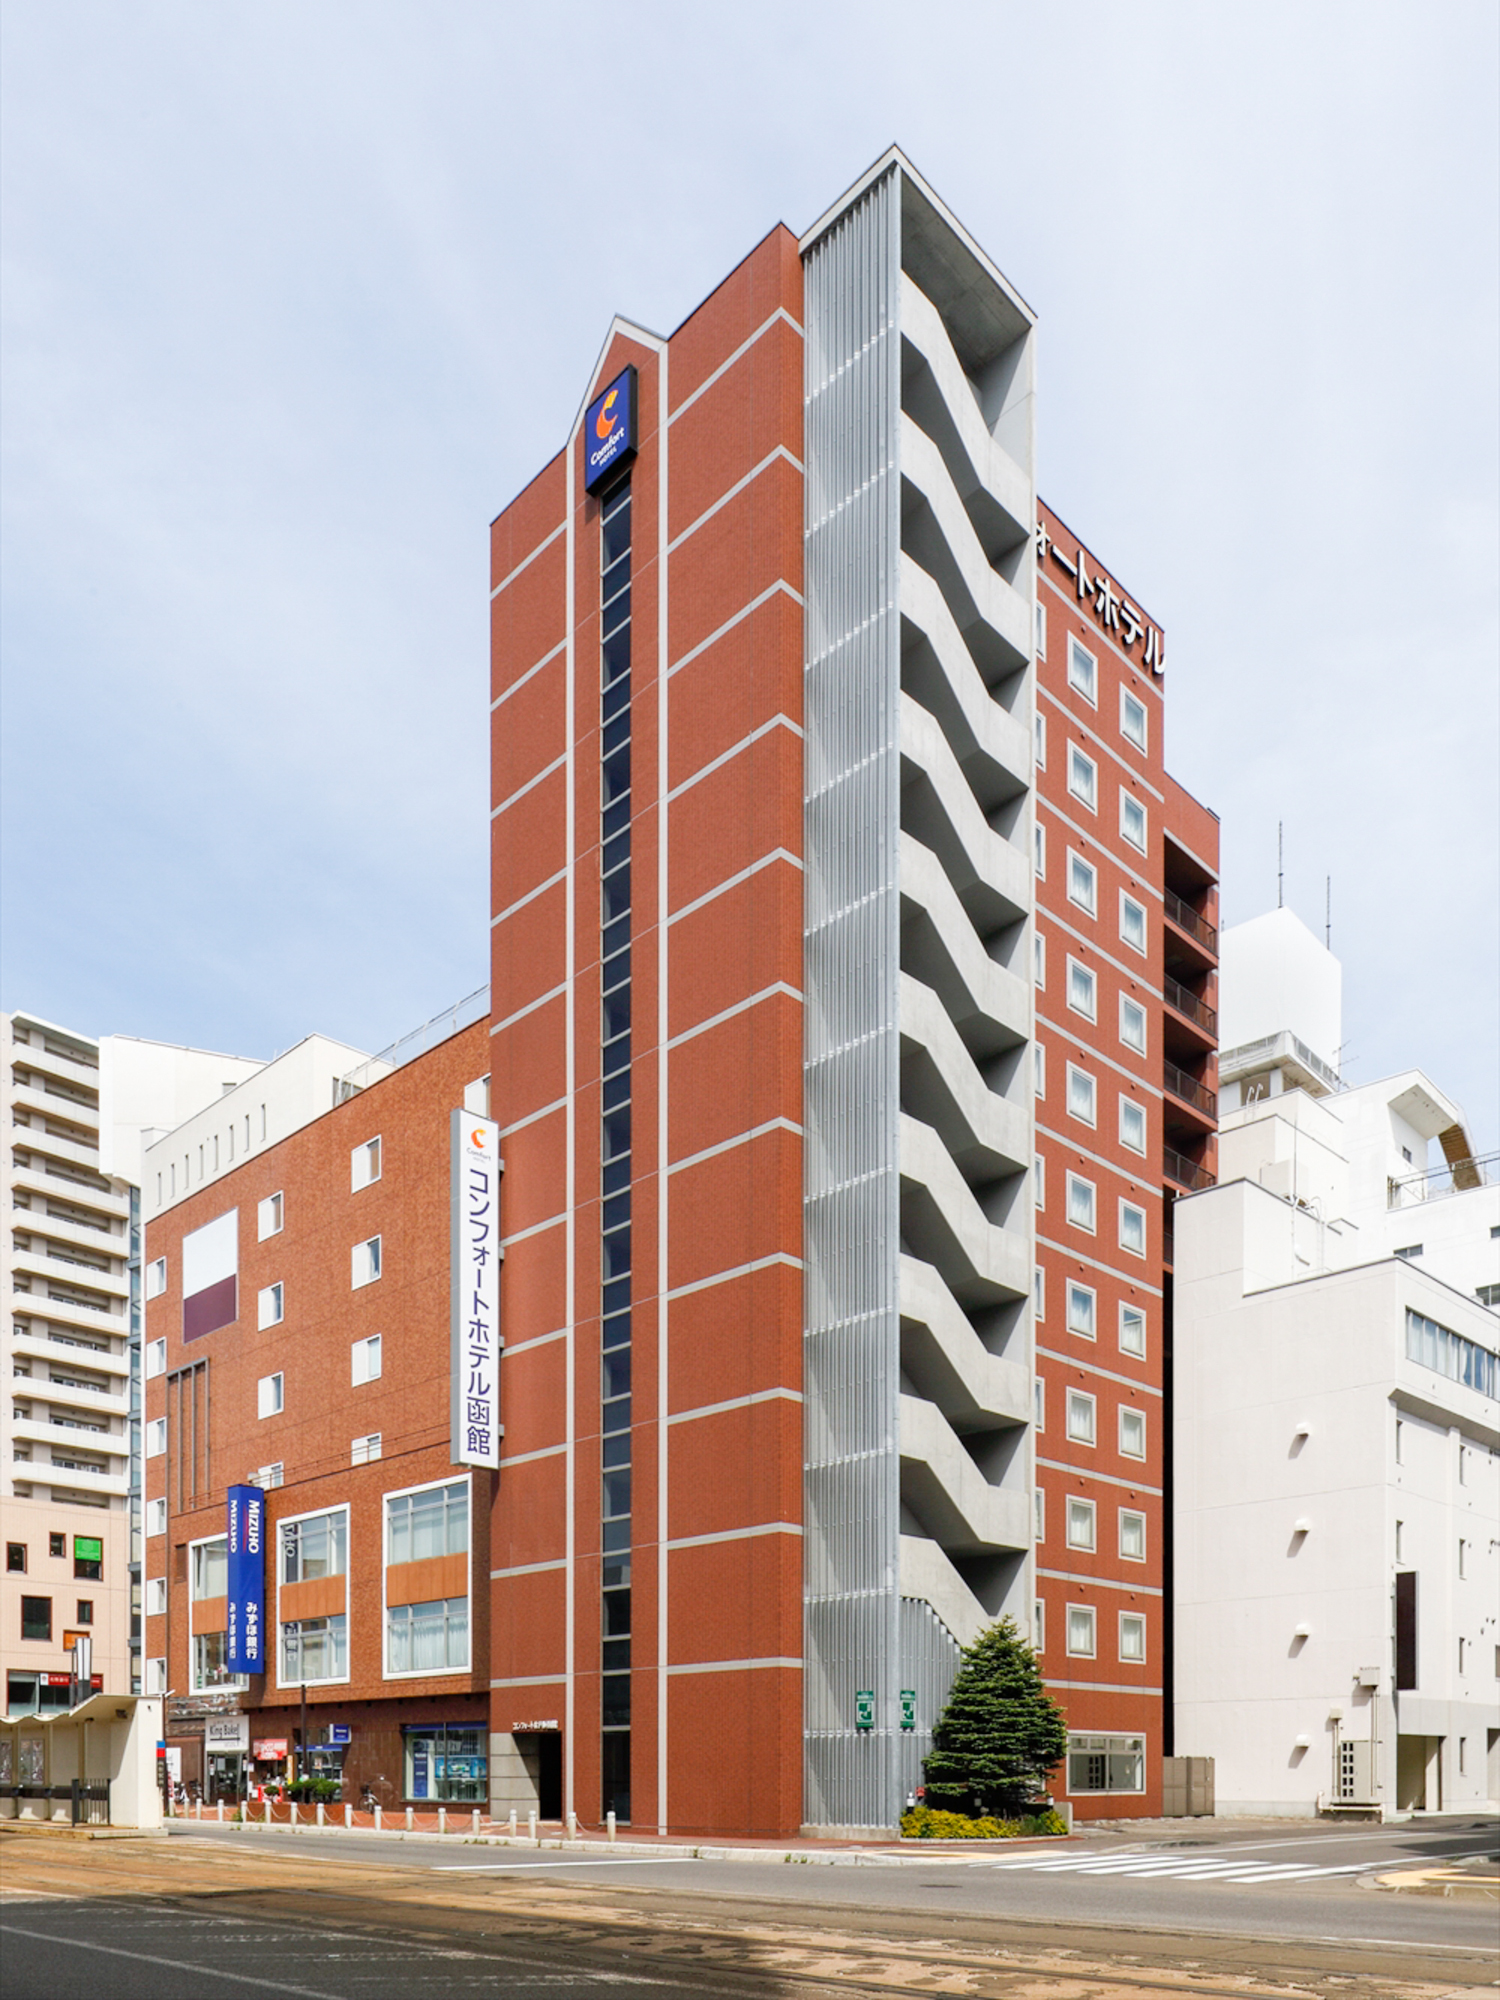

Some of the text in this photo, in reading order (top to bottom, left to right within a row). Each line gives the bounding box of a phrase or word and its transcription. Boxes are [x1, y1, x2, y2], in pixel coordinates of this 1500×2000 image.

[590, 426, 625, 466] Comfort
[467, 1167, 491, 1456] コンフォートホテル函館
[230, 1499, 238, 1554] MIZUHO
[248, 1499, 261, 1554] MIZUHO
[246, 1601, 259, 1660] みずほ銀行
